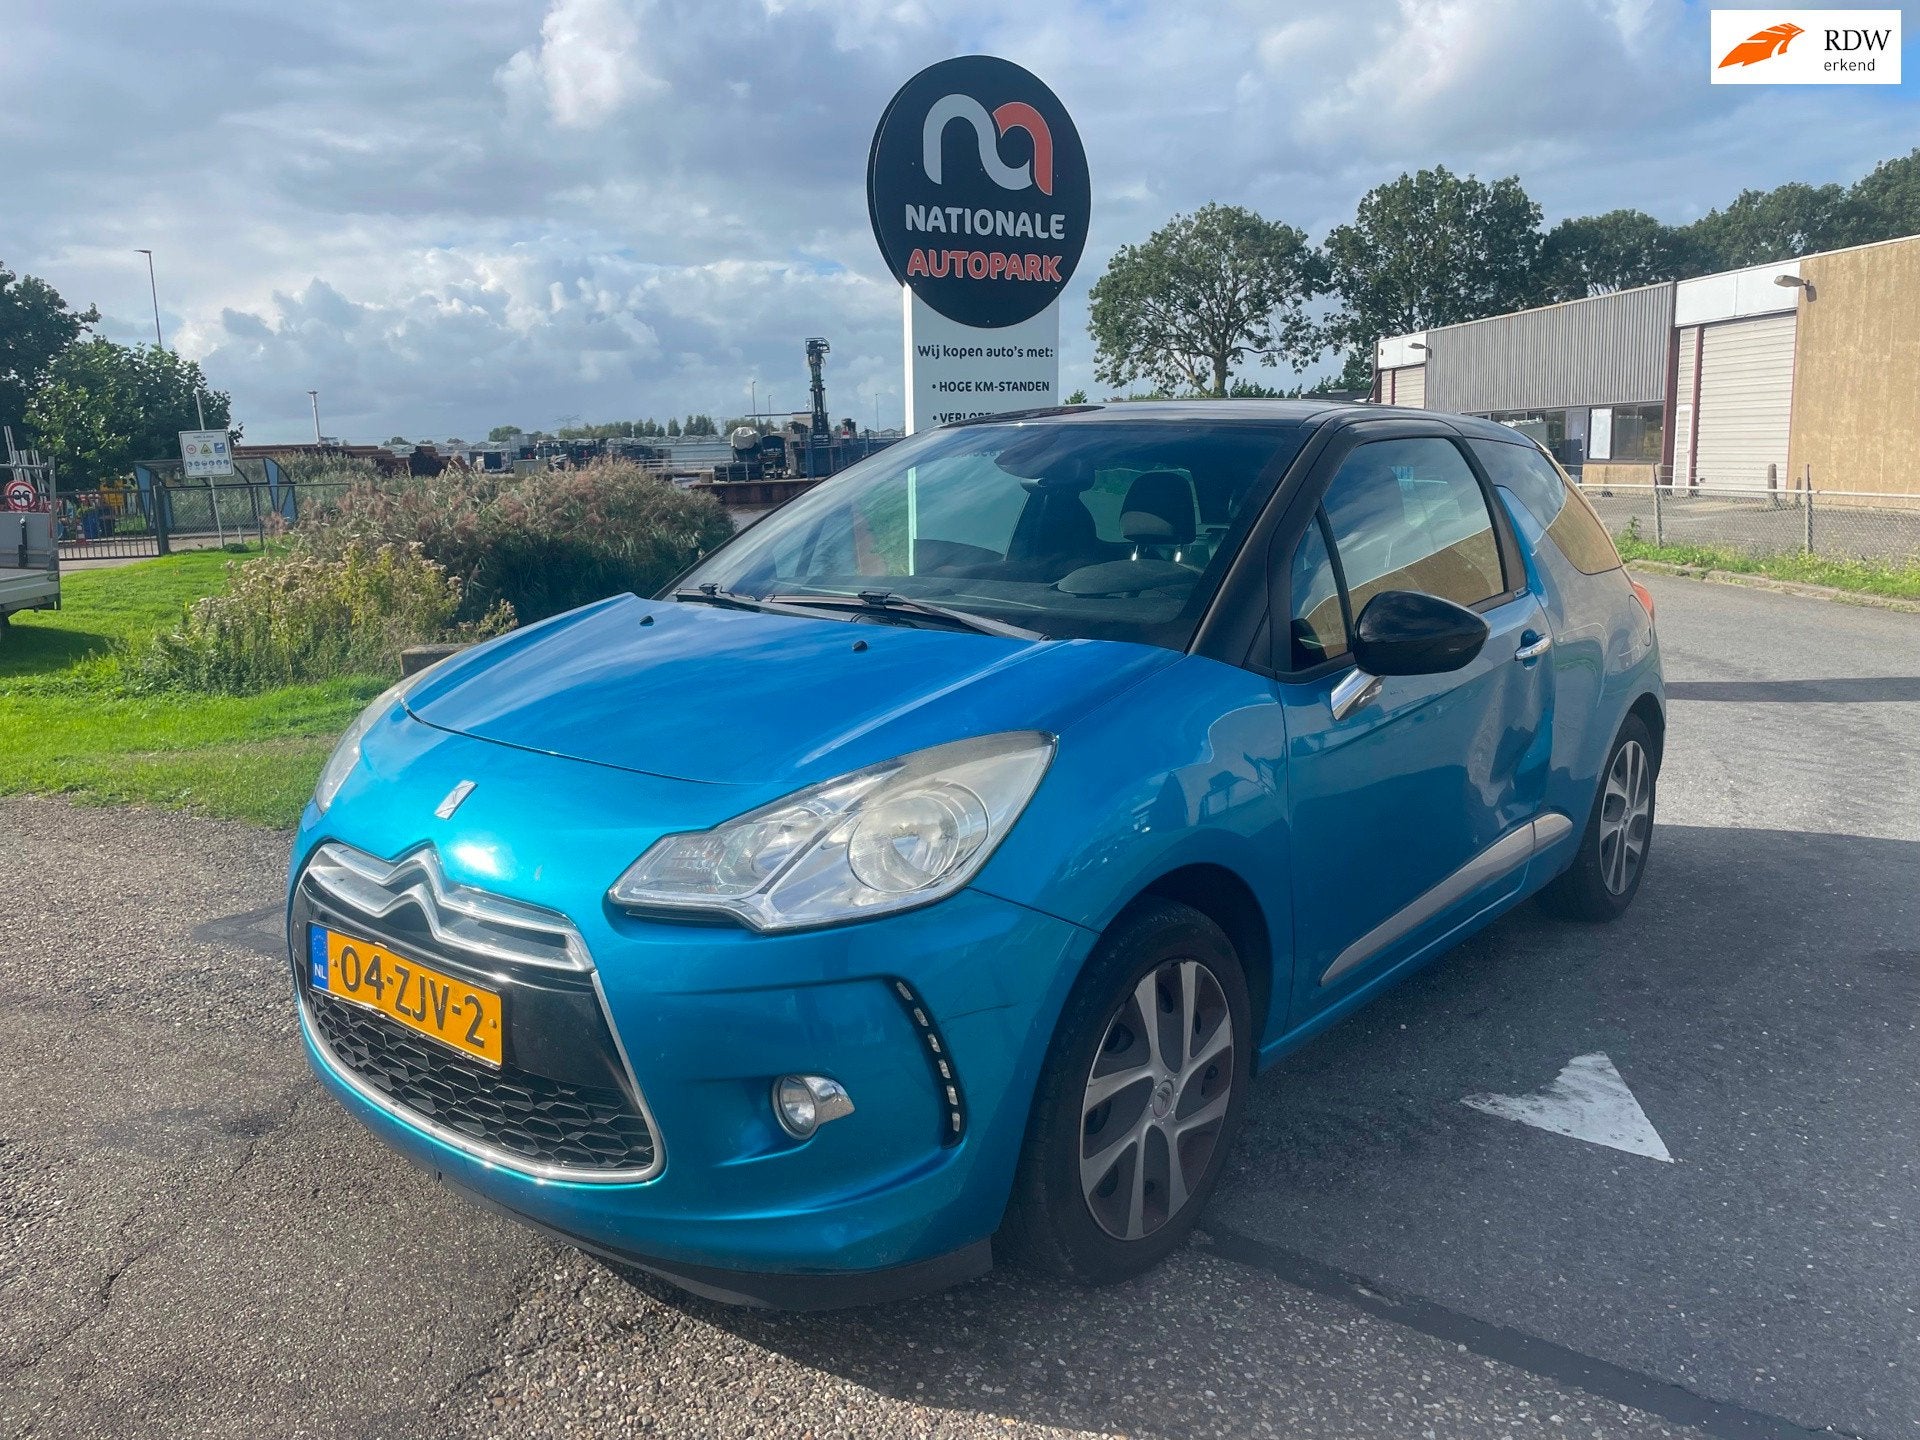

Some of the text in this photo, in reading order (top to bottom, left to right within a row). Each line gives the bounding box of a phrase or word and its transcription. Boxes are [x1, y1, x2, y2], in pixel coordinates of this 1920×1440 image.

[905, 204, 1065, 240] NATIONALE
[907, 248, 1063, 283] AUTOPARK
[917, 345, 1054, 359] Wij kopen auto's met:
[939, 381, 1050, 392] HOGE KM-STANDEN
[314, 962, 327, 980] NL
[341, 944, 485, 1049] 04-ZJV-2
